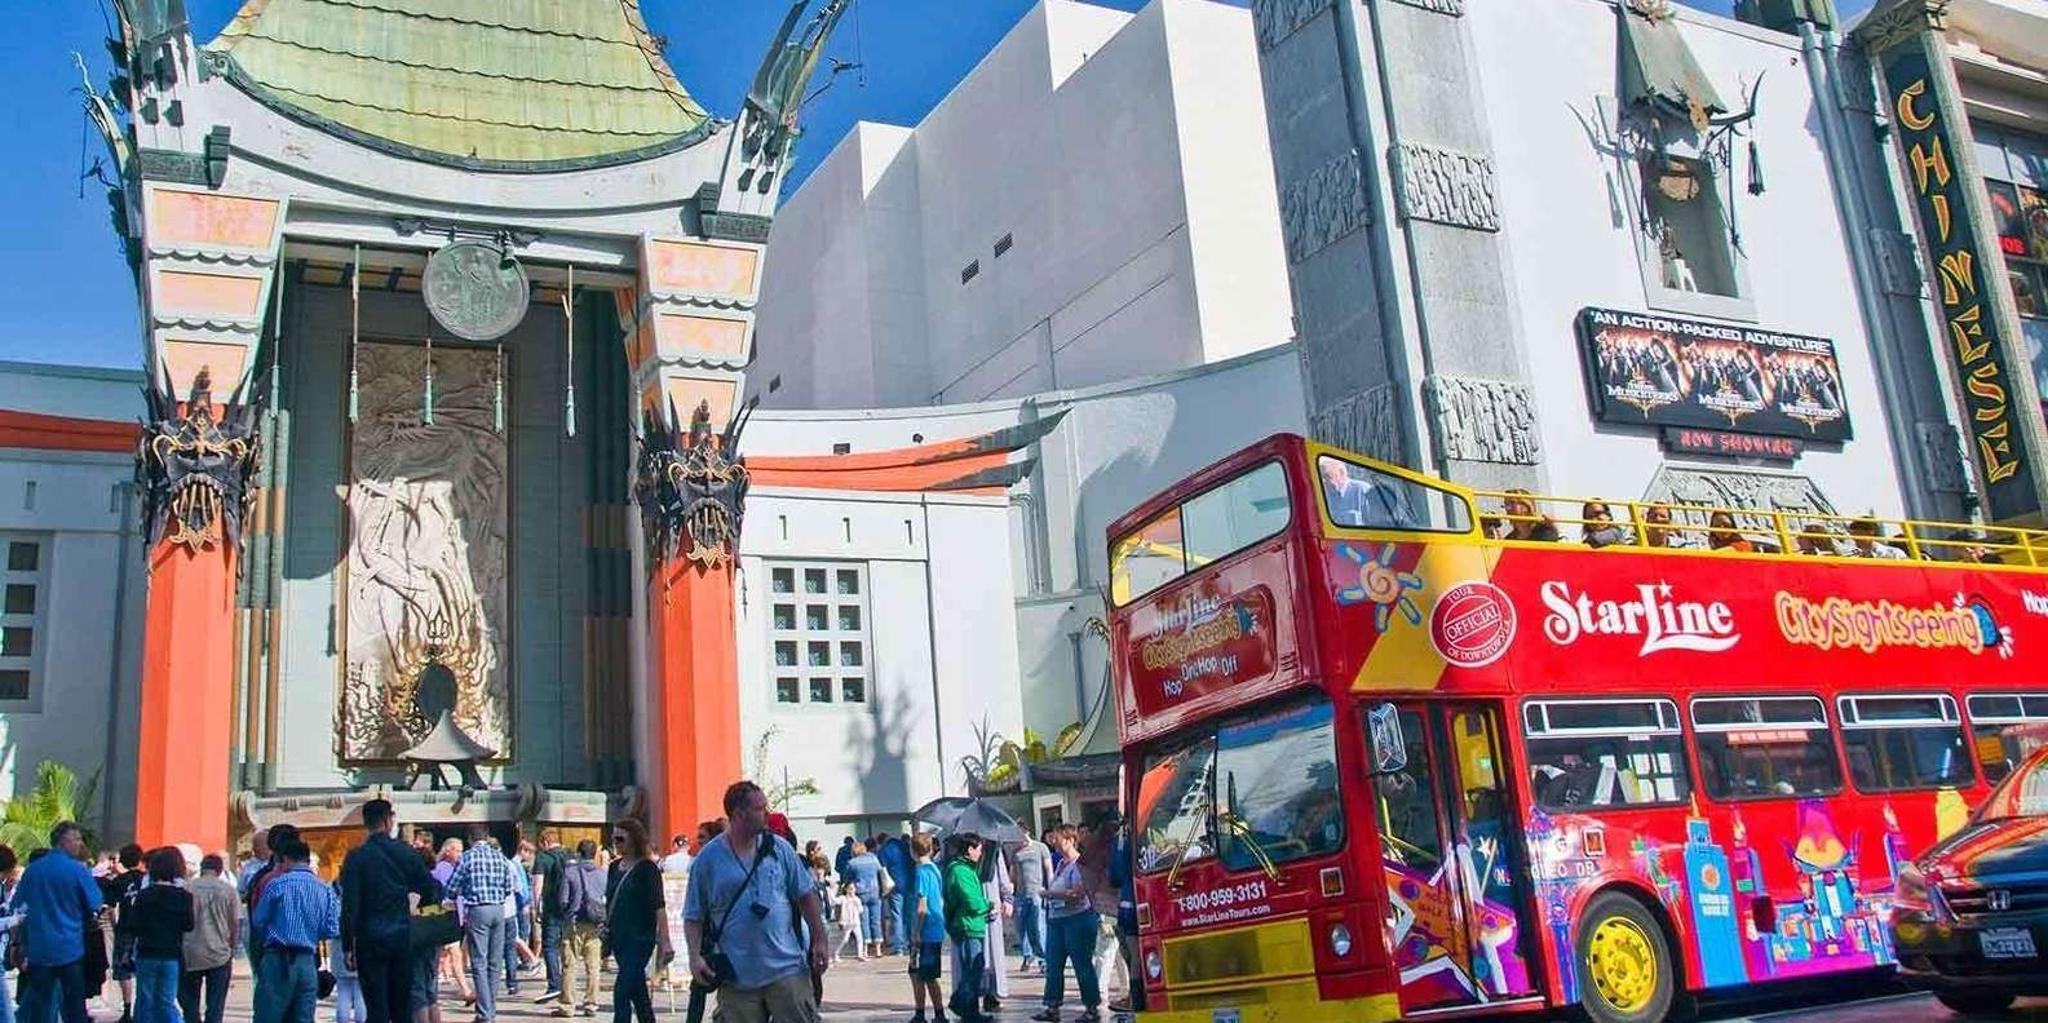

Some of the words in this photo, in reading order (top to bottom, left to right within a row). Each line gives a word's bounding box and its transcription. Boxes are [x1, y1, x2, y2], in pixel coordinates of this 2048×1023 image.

[1898, 78, 2020, 484] CHINESE
[1621, 315, 1743, 341] ACTION-PACKED
[1680, 430, 1712, 447] NOW
[1719, 434, 1795, 456] SHOWING
[1446, 603, 1499, 640] OFFICIAL
[1541, 579, 1742, 657] StarLine
[1775, 590, 1984, 655] CitySightseeing
[1163, 680, 1183, 697] Hop
[1221, 654, 1238, 676] Off
[1178, 881, 1267, 912] 1-800-959-3131
